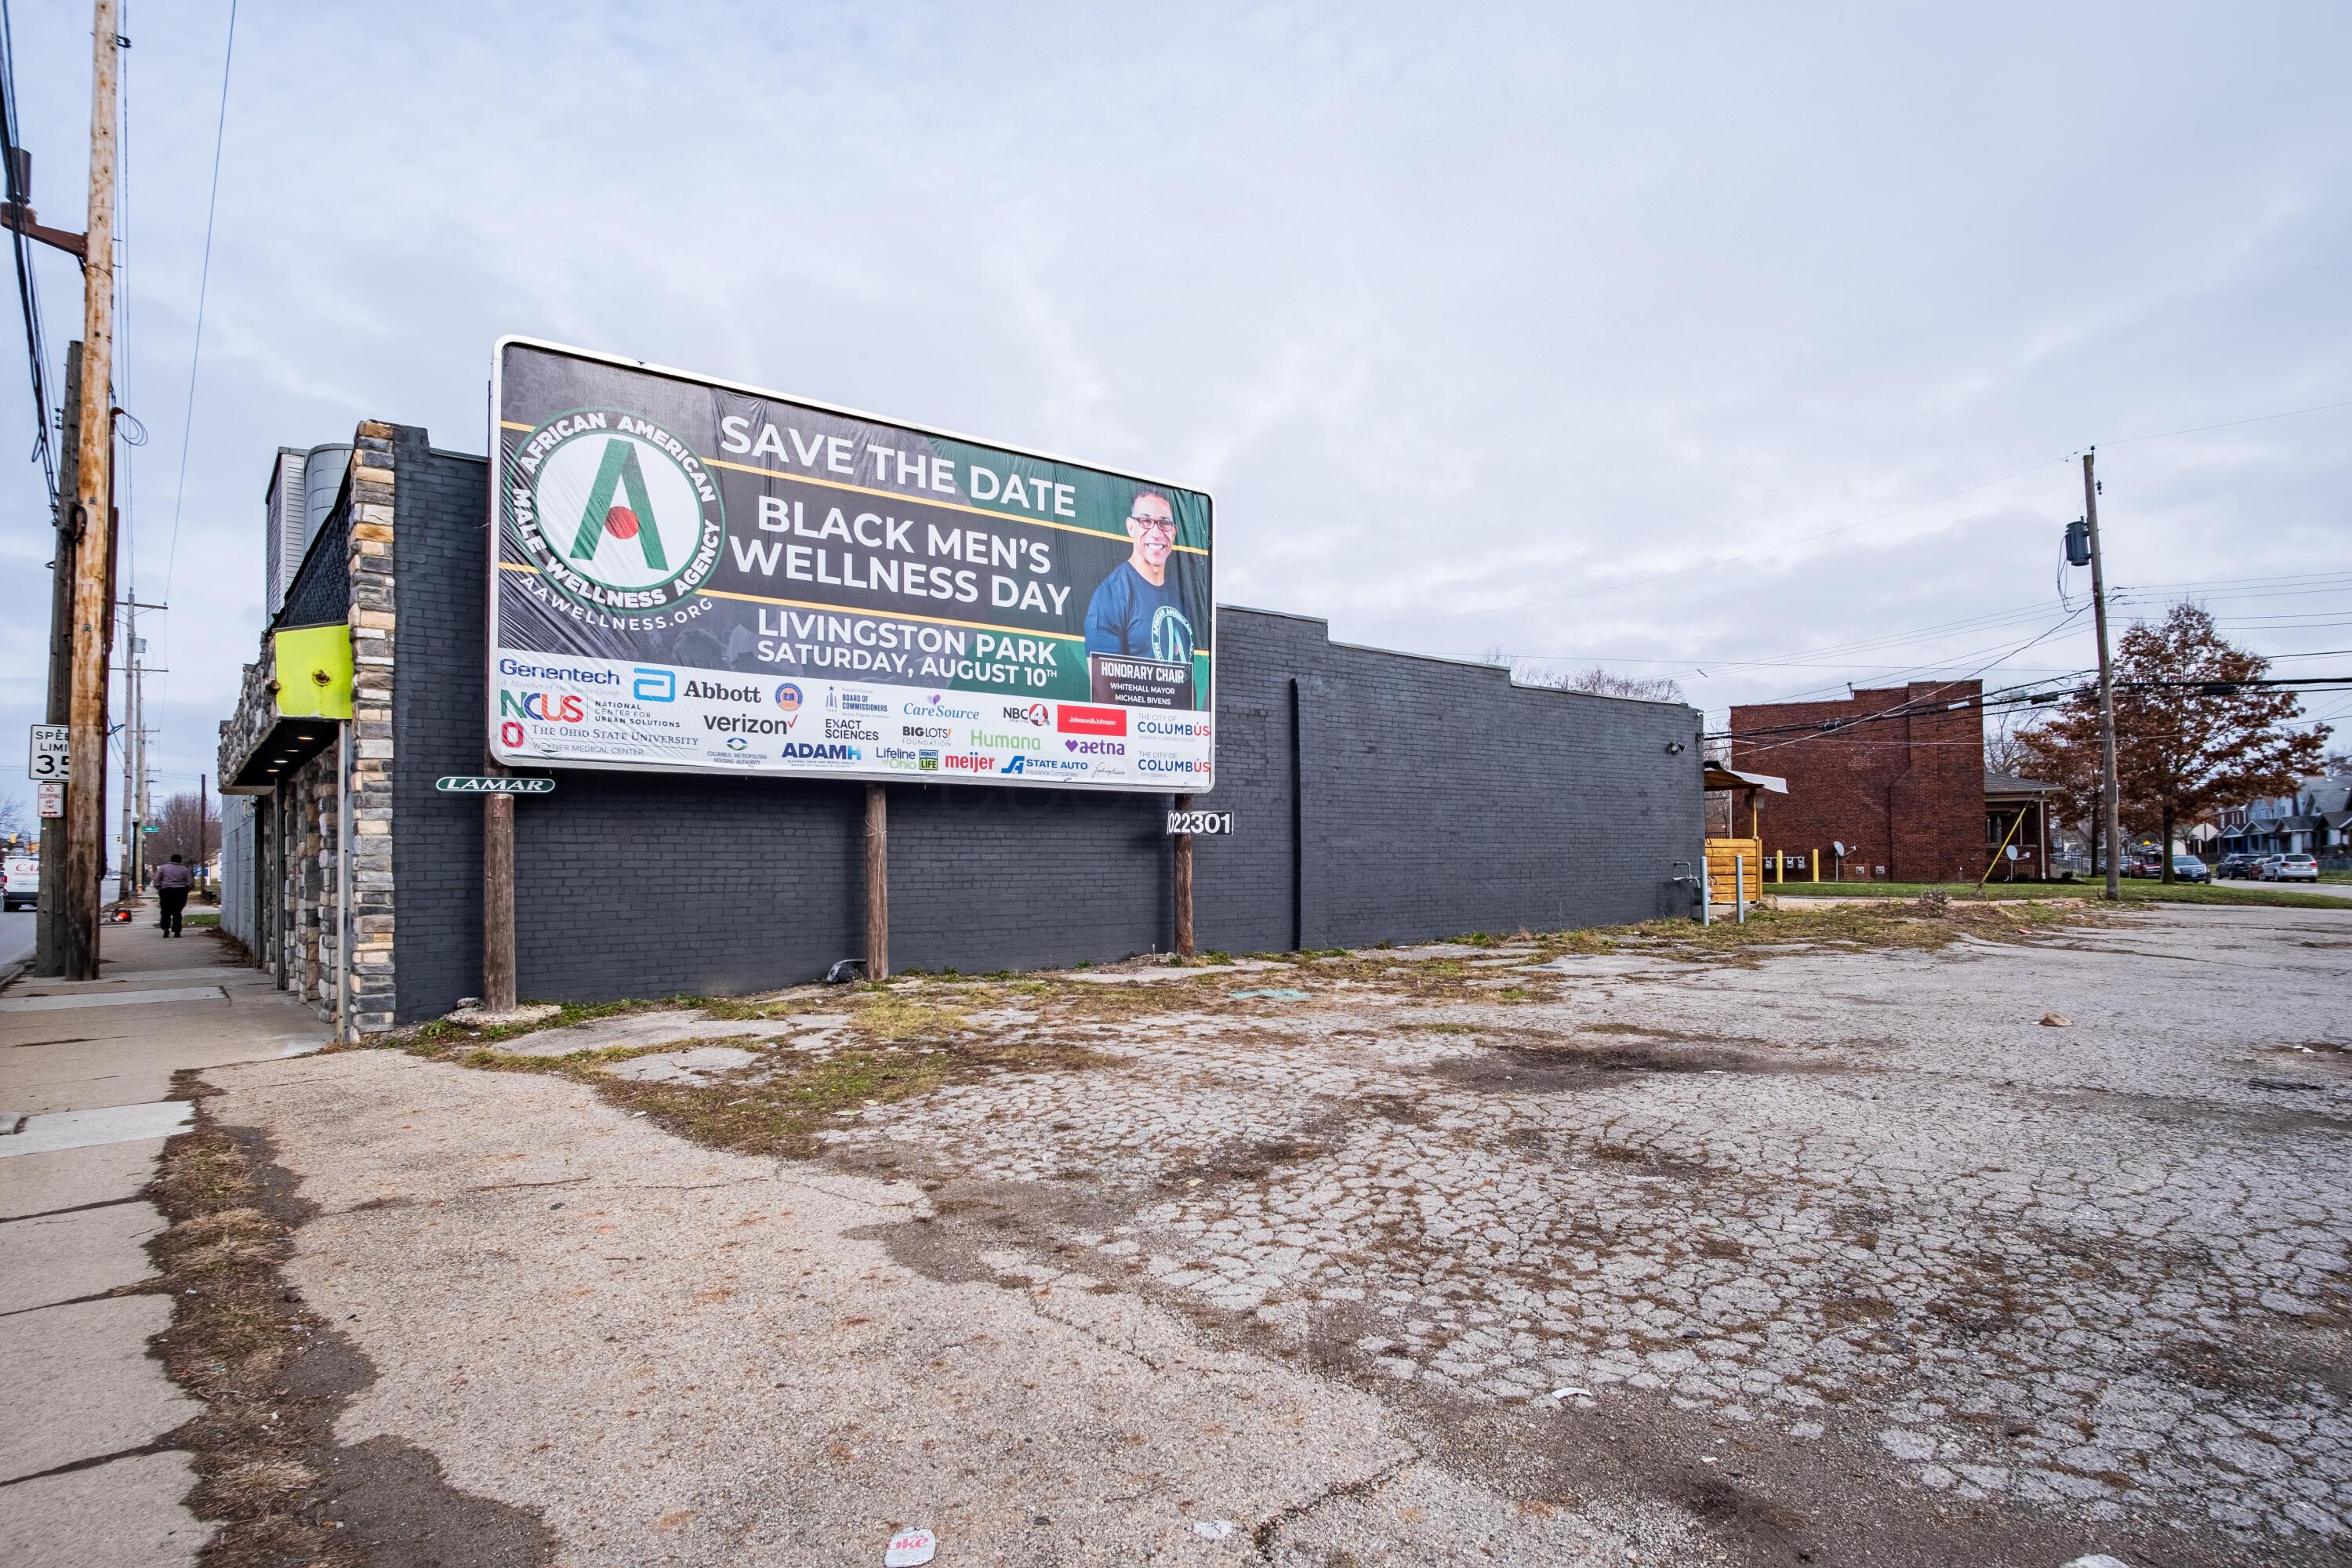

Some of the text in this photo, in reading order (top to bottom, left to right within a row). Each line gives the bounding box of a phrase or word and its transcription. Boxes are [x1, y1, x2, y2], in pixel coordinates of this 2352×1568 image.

[520, 412, 716, 503] AFRICAN AMERICAN
[720, 416, 1076, 517] SAVE THE DATE
[758, 495, 915, 554] BLACK
[513, 488, 720, 608] MALE WELLNESS AGENCY
[729, 535, 1071, 615] WELLNESS DAY
[520, 576, 713, 631] AAWELLNESS.ORG
[758, 608, 1058, 666] LIVINGSTON PARK
[757, 640, 913, 677] SATURDAY,
[920, 656, 1019, 684] AUGUST
[499, 659, 620, 685] Genentech
[1101, 662, 1184, 684] HONORARY CHAIR
[511, 680, 544, 690] Member
[596, 688, 620, 698] Group
[684, 680, 761, 703] Abbott
[1110, 682, 1175, 695] WHITEHALL MAYOR
[500, 689, 584, 723] NCUS
[596, 701, 641, 710] NATIONAL
[842, 694, 861, 702] BOARD
[1115, 694, 1171, 705] MICHAEL BIVENS
[842, 702, 888, 712] COMMISSIONERS
[903, 702, 979, 720] CareSource
[630, 718, 680, 728] SOLUTIONS
[703, 713, 787, 735] verizon
[826, 718, 862, 730] EXACT
[1138, 721, 1210, 737] COLUMBUS
[35, 731, 69, 741] SPEE
[825, 729, 880, 741] SCIENCES
[971, 729, 1041, 750] Humana
[40, 742, 68, 752] LIMI
[572, 744, 609, 754] MEDICAL
[612, 747, 644, 756] CENTER
[782, 742, 862, 760] ADAMH
[877, 746, 916, 760] Lifeline
[1079, 739, 1125, 756] aetna
[889, 758, 916, 770] Ohio
[920, 759, 937, 769] LIFE
[945, 751, 995, 773] meijer
[1026, 759, 1088, 770] STATE AUTO
[1138, 759, 1210, 773] COLUMBUS
[447, 779, 544, 791] LAMAR
[1168, 812, 1230, 833] 022301
[888, 1537, 929, 1551] oke
